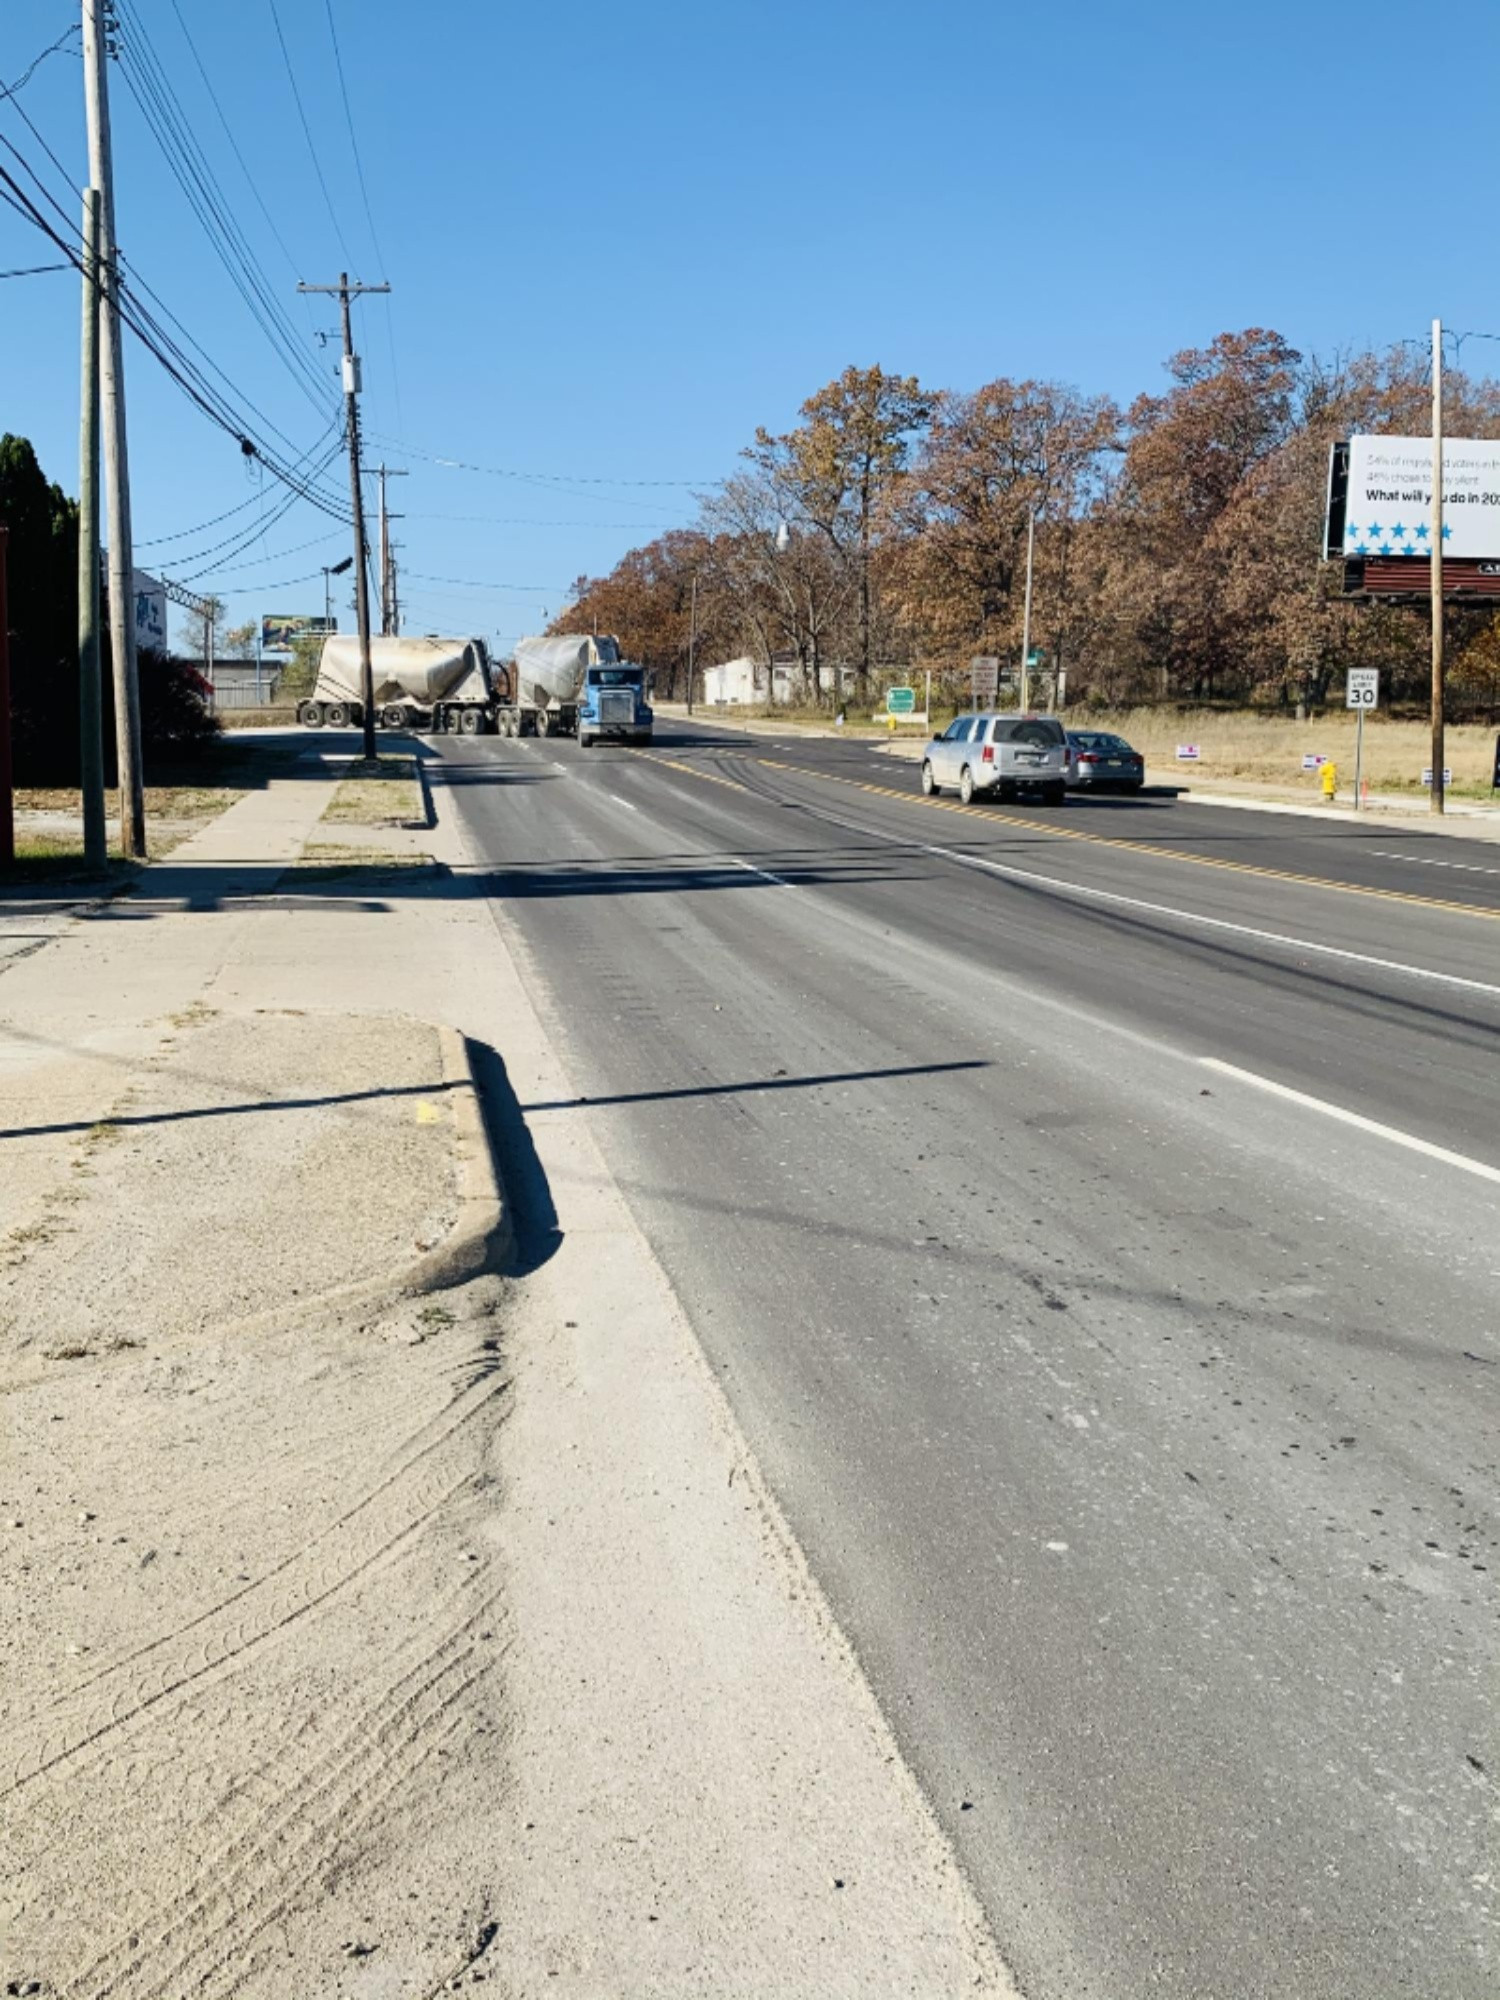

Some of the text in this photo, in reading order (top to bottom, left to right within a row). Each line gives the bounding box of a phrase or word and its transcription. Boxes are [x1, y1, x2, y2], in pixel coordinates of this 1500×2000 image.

[1366, 489, 1500, 506] What will yu do in 20
[1351, 689, 1374, 703] 30
